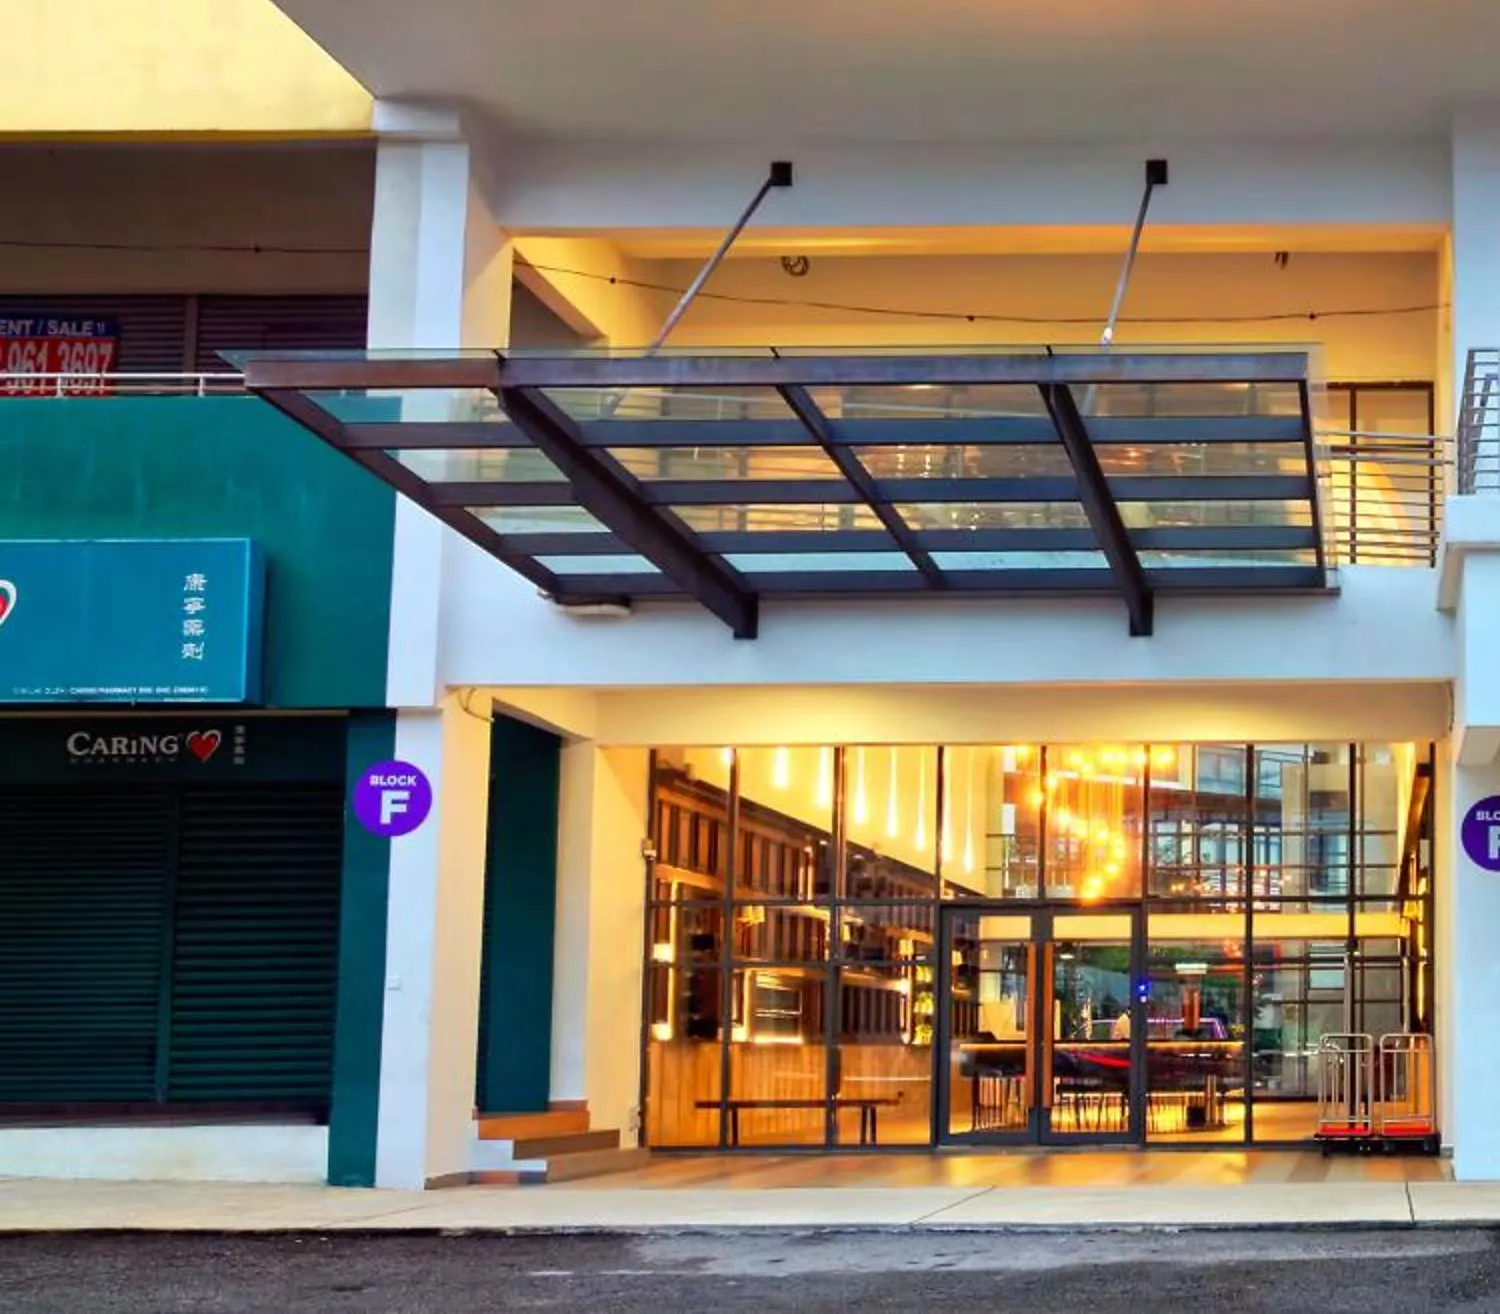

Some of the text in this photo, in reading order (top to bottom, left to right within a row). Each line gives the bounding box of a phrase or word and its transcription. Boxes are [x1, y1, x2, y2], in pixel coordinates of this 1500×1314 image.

[47, 320, 93, 338] SALE
[369, 774, 418, 787] BLOCK
[380, 789, 411, 825] F
